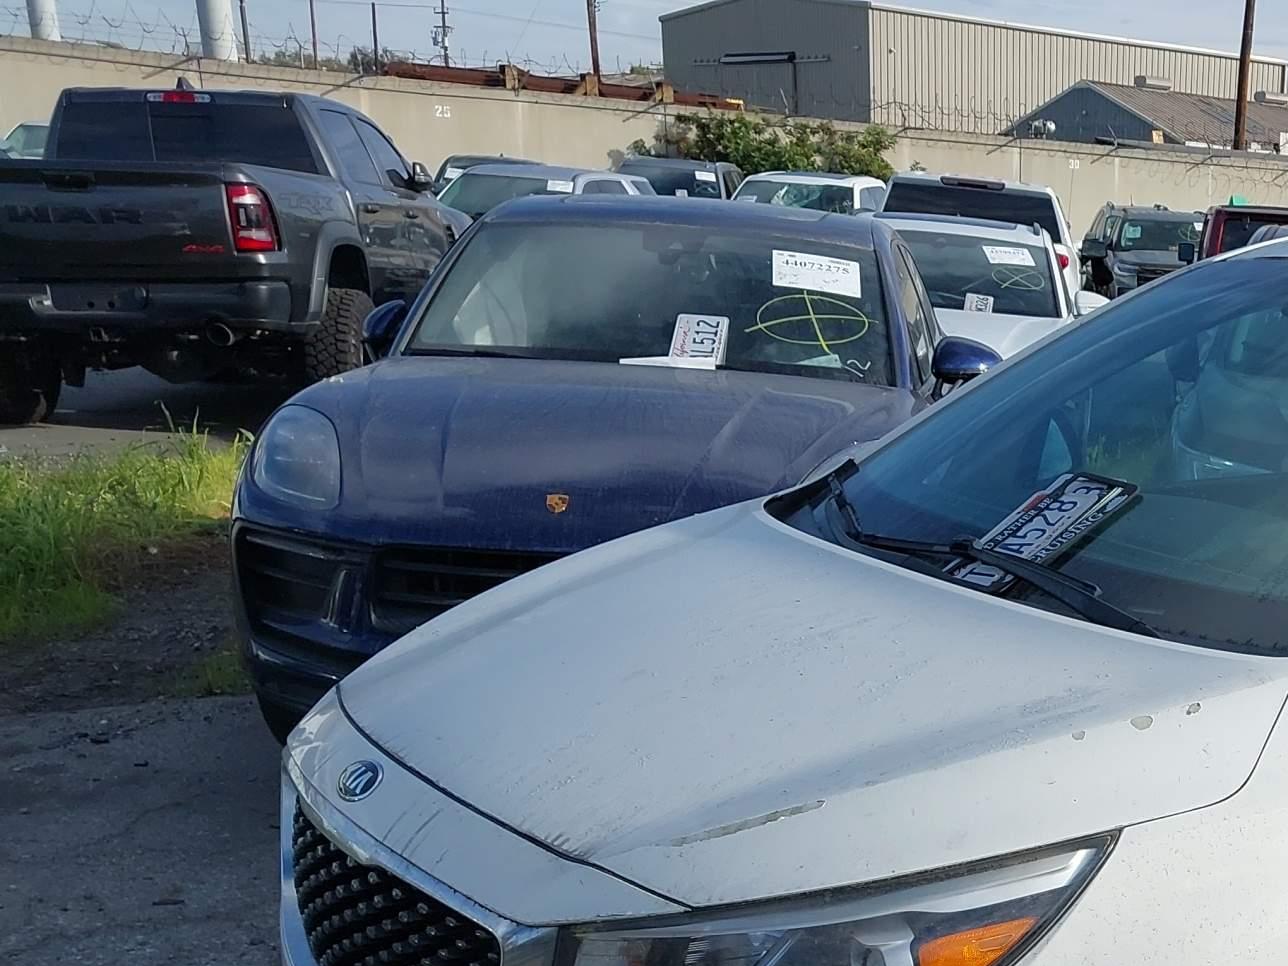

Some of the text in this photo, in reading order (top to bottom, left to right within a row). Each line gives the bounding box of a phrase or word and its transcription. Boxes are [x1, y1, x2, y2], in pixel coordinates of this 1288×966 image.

[435, 105, 451, 118] 25
[962, 485, 1109, 579] TA5283
[995, 510, 1038, 541] RATHER
